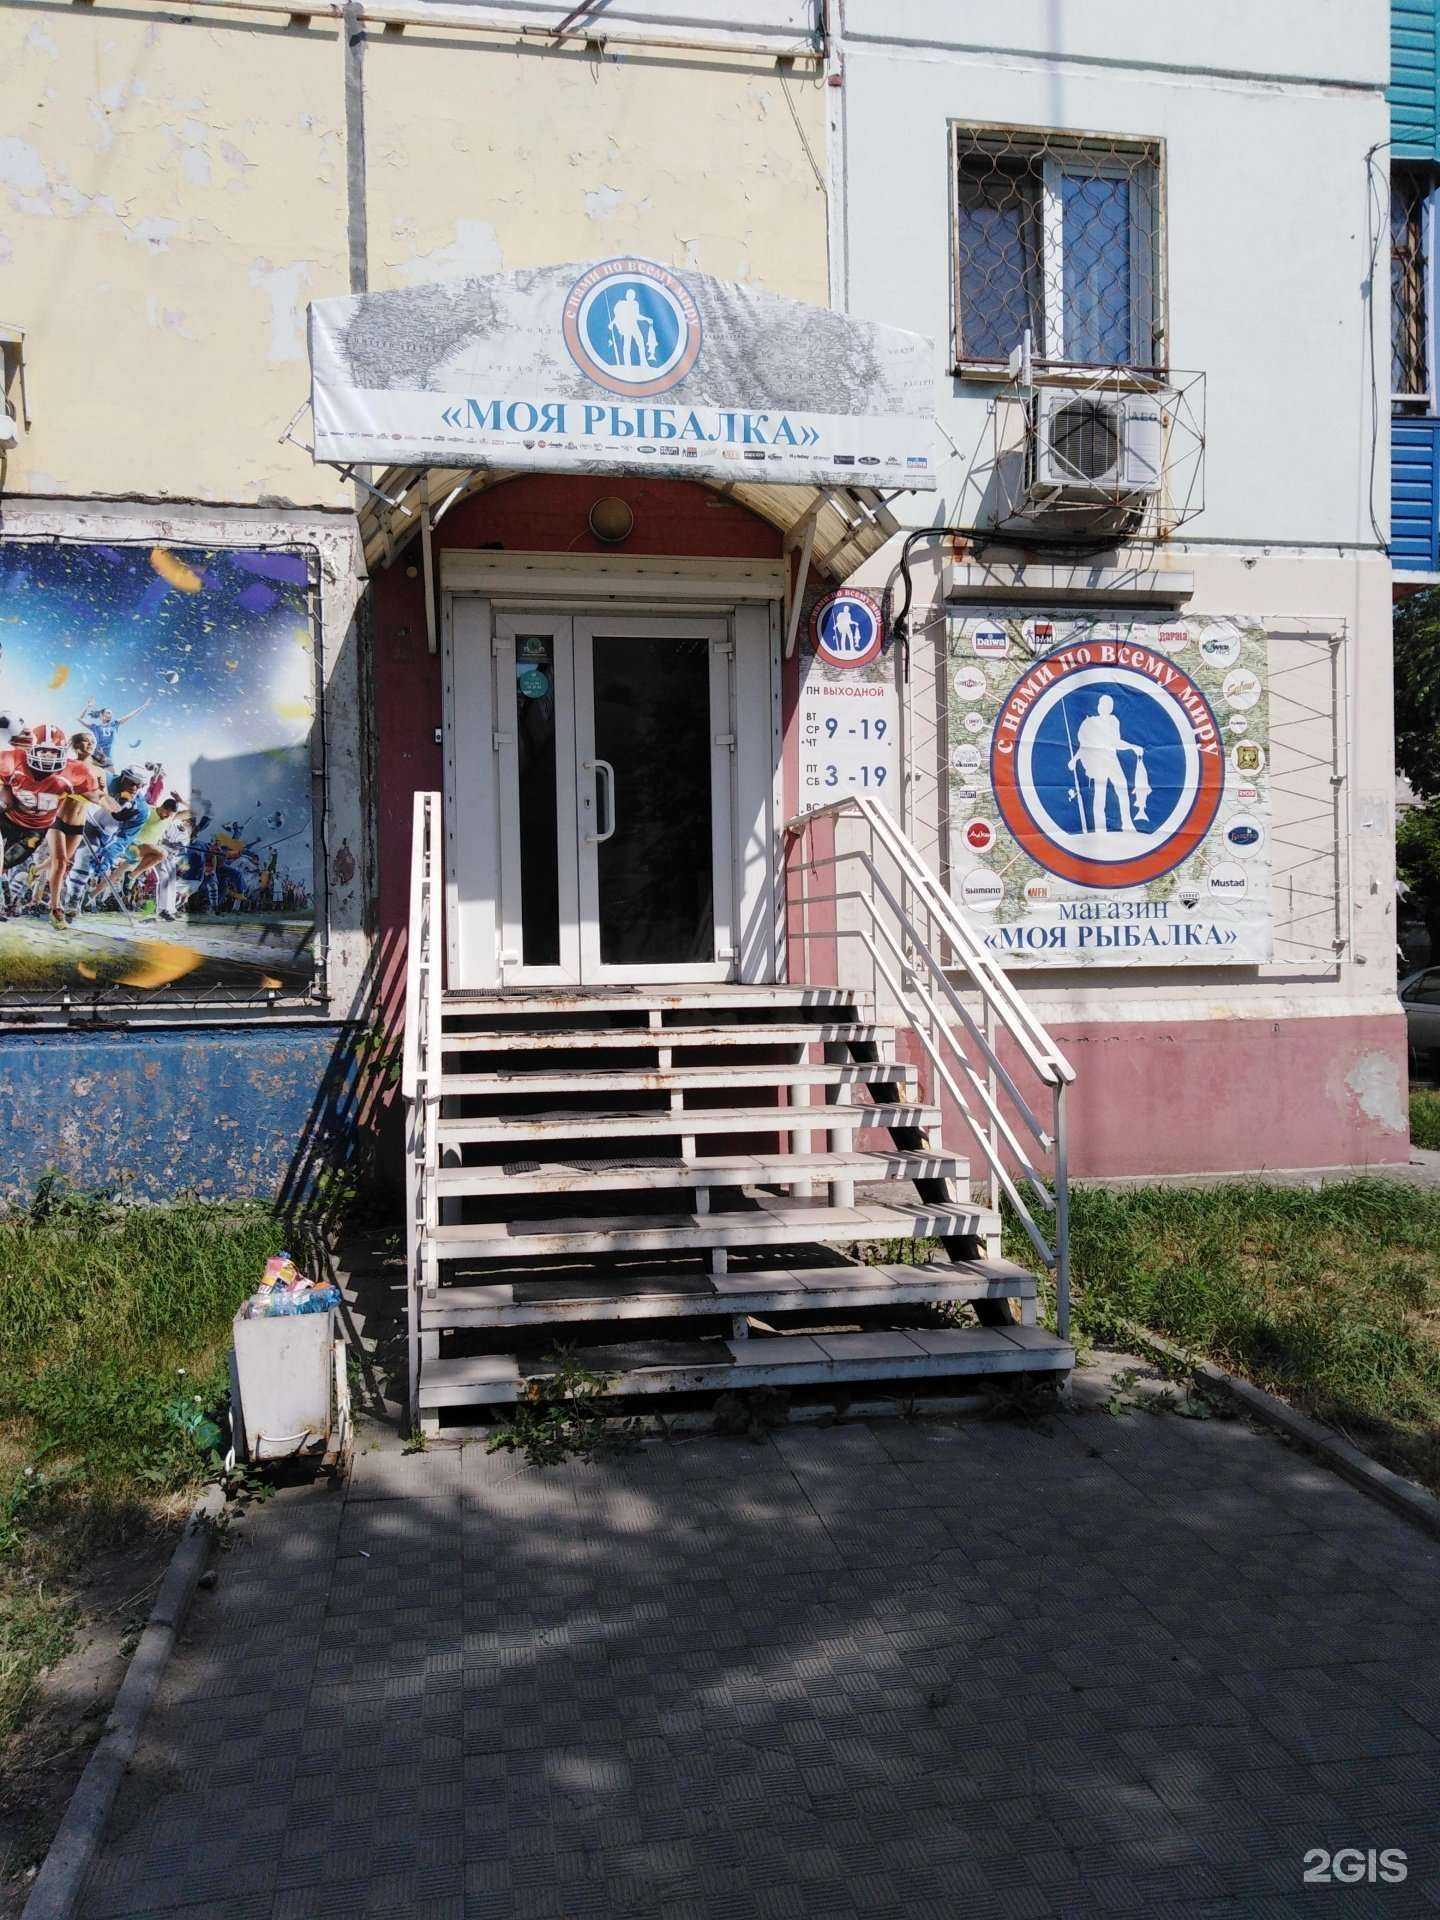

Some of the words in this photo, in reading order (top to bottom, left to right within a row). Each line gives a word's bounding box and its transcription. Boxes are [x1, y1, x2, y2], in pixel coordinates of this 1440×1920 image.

[441, 398, 567, 433] «МОЯ
[583, 404, 820, 447] РЫБАЛКА»
[806, 686, 820, 695] ПН
[823, 686, 884, 697] ВЫХОДНОЙ
[806, 712, 817, 721] ВТ
[806, 725, 820, 734] СР
[806, 738, 817, 748] ЧТ
[806, 764, 817, 773] ПТ
[806, 777, 820, 786] СБ
[1211, 878, 1245, 887] Mustad
[1059, 901, 1169, 922] магазин
[983, 926, 1066, 949] «МОЯ
[1078, 923, 1238, 949] РЫБАЛКА»
